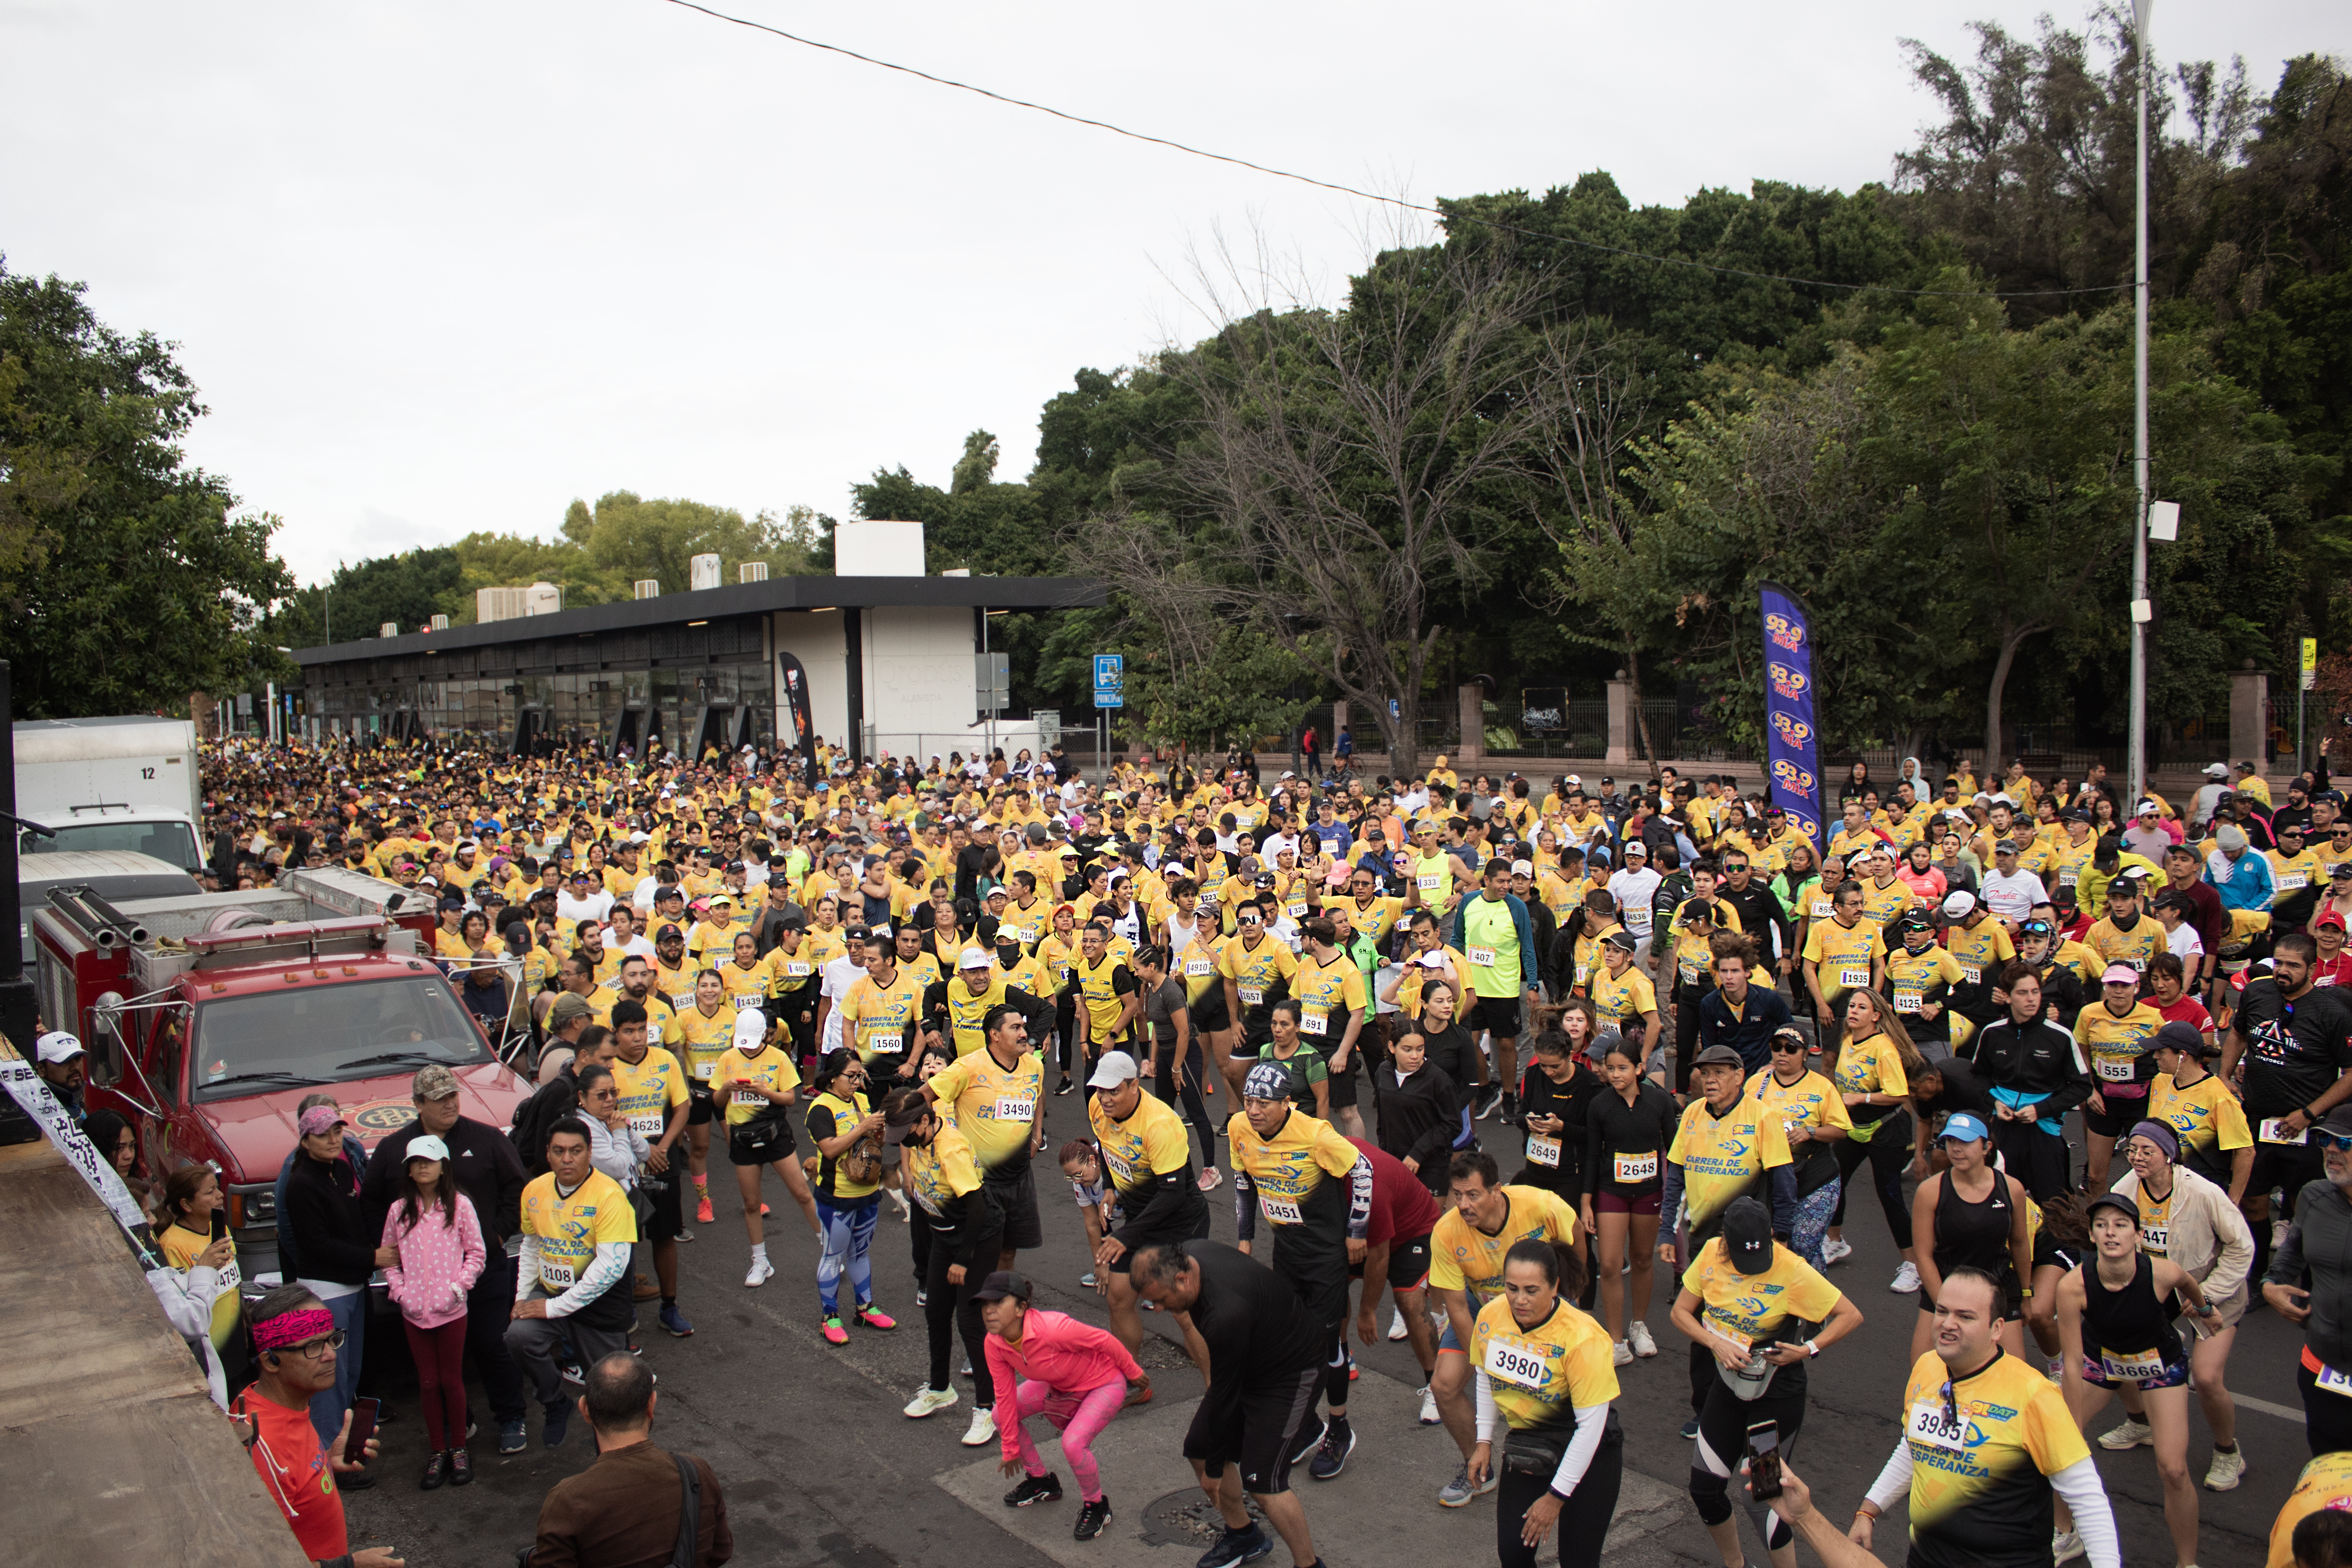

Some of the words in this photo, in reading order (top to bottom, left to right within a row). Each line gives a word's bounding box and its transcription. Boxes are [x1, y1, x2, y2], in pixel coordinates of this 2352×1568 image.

[1766, 614, 1802, 640] 93.9
[1769, 663, 1805, 689] 93.9
[901, 694, 942, 702] ALAMEDA
[1774, 712, 1808, 738] 93.9
[141, 767, 155, 779] 12
[1774, 760, 1813, 787] 93.9
[1475, 953, 1490, 962] 407
[1848, 974, 1868, 983] 1935
[675, 996, 694, 1007] 1638
[741, 997, 761, 1006] 1439
[1243, 992, 1260, 1001] 1657
[1898, 998, 1920, 1008] 4125
[1306, 1019, 1321, 1030] 691
[877, 1039, 900, 1048] 1560
[2105, 1066, 2127, 1076] 555
[1004, 1104, 1030, 1116] 3490
[632, 1120, 661, 1131] 4628
[1531, 1143, 1556, 1160] 2649
[1108, 1157, 1130, 1177] 3478
[1686, 1155, 1723, 1165] CARRERA
[1725, 1158, 1741, 1167] DE
[1623, 1162, 1654, 1176] 2648
[1695, 1164, 1750, 1176] ESPERANZA
[1284, 1180, 1298, 1189] DE
[1268, 1204, 1298, 1219] 3451
[2142, 1230, 2168, 1245] 447
[571, 1240, 583, 1248] DE
[220, 1266, 240, 1286] 4791
[544, 1265, 571, 1282] 3108
[1741, 1317, 1759, 1327] DE
[1496, 1350, 1539, 1379] 3980
[2115, 1364, 2161, 1378] 3666
[1917, 1413, 1963, 1441] 3985
[1957, 1449, 1977, 1463] DE
[1911, 1451, 1989, 1478] ESPERANZA
